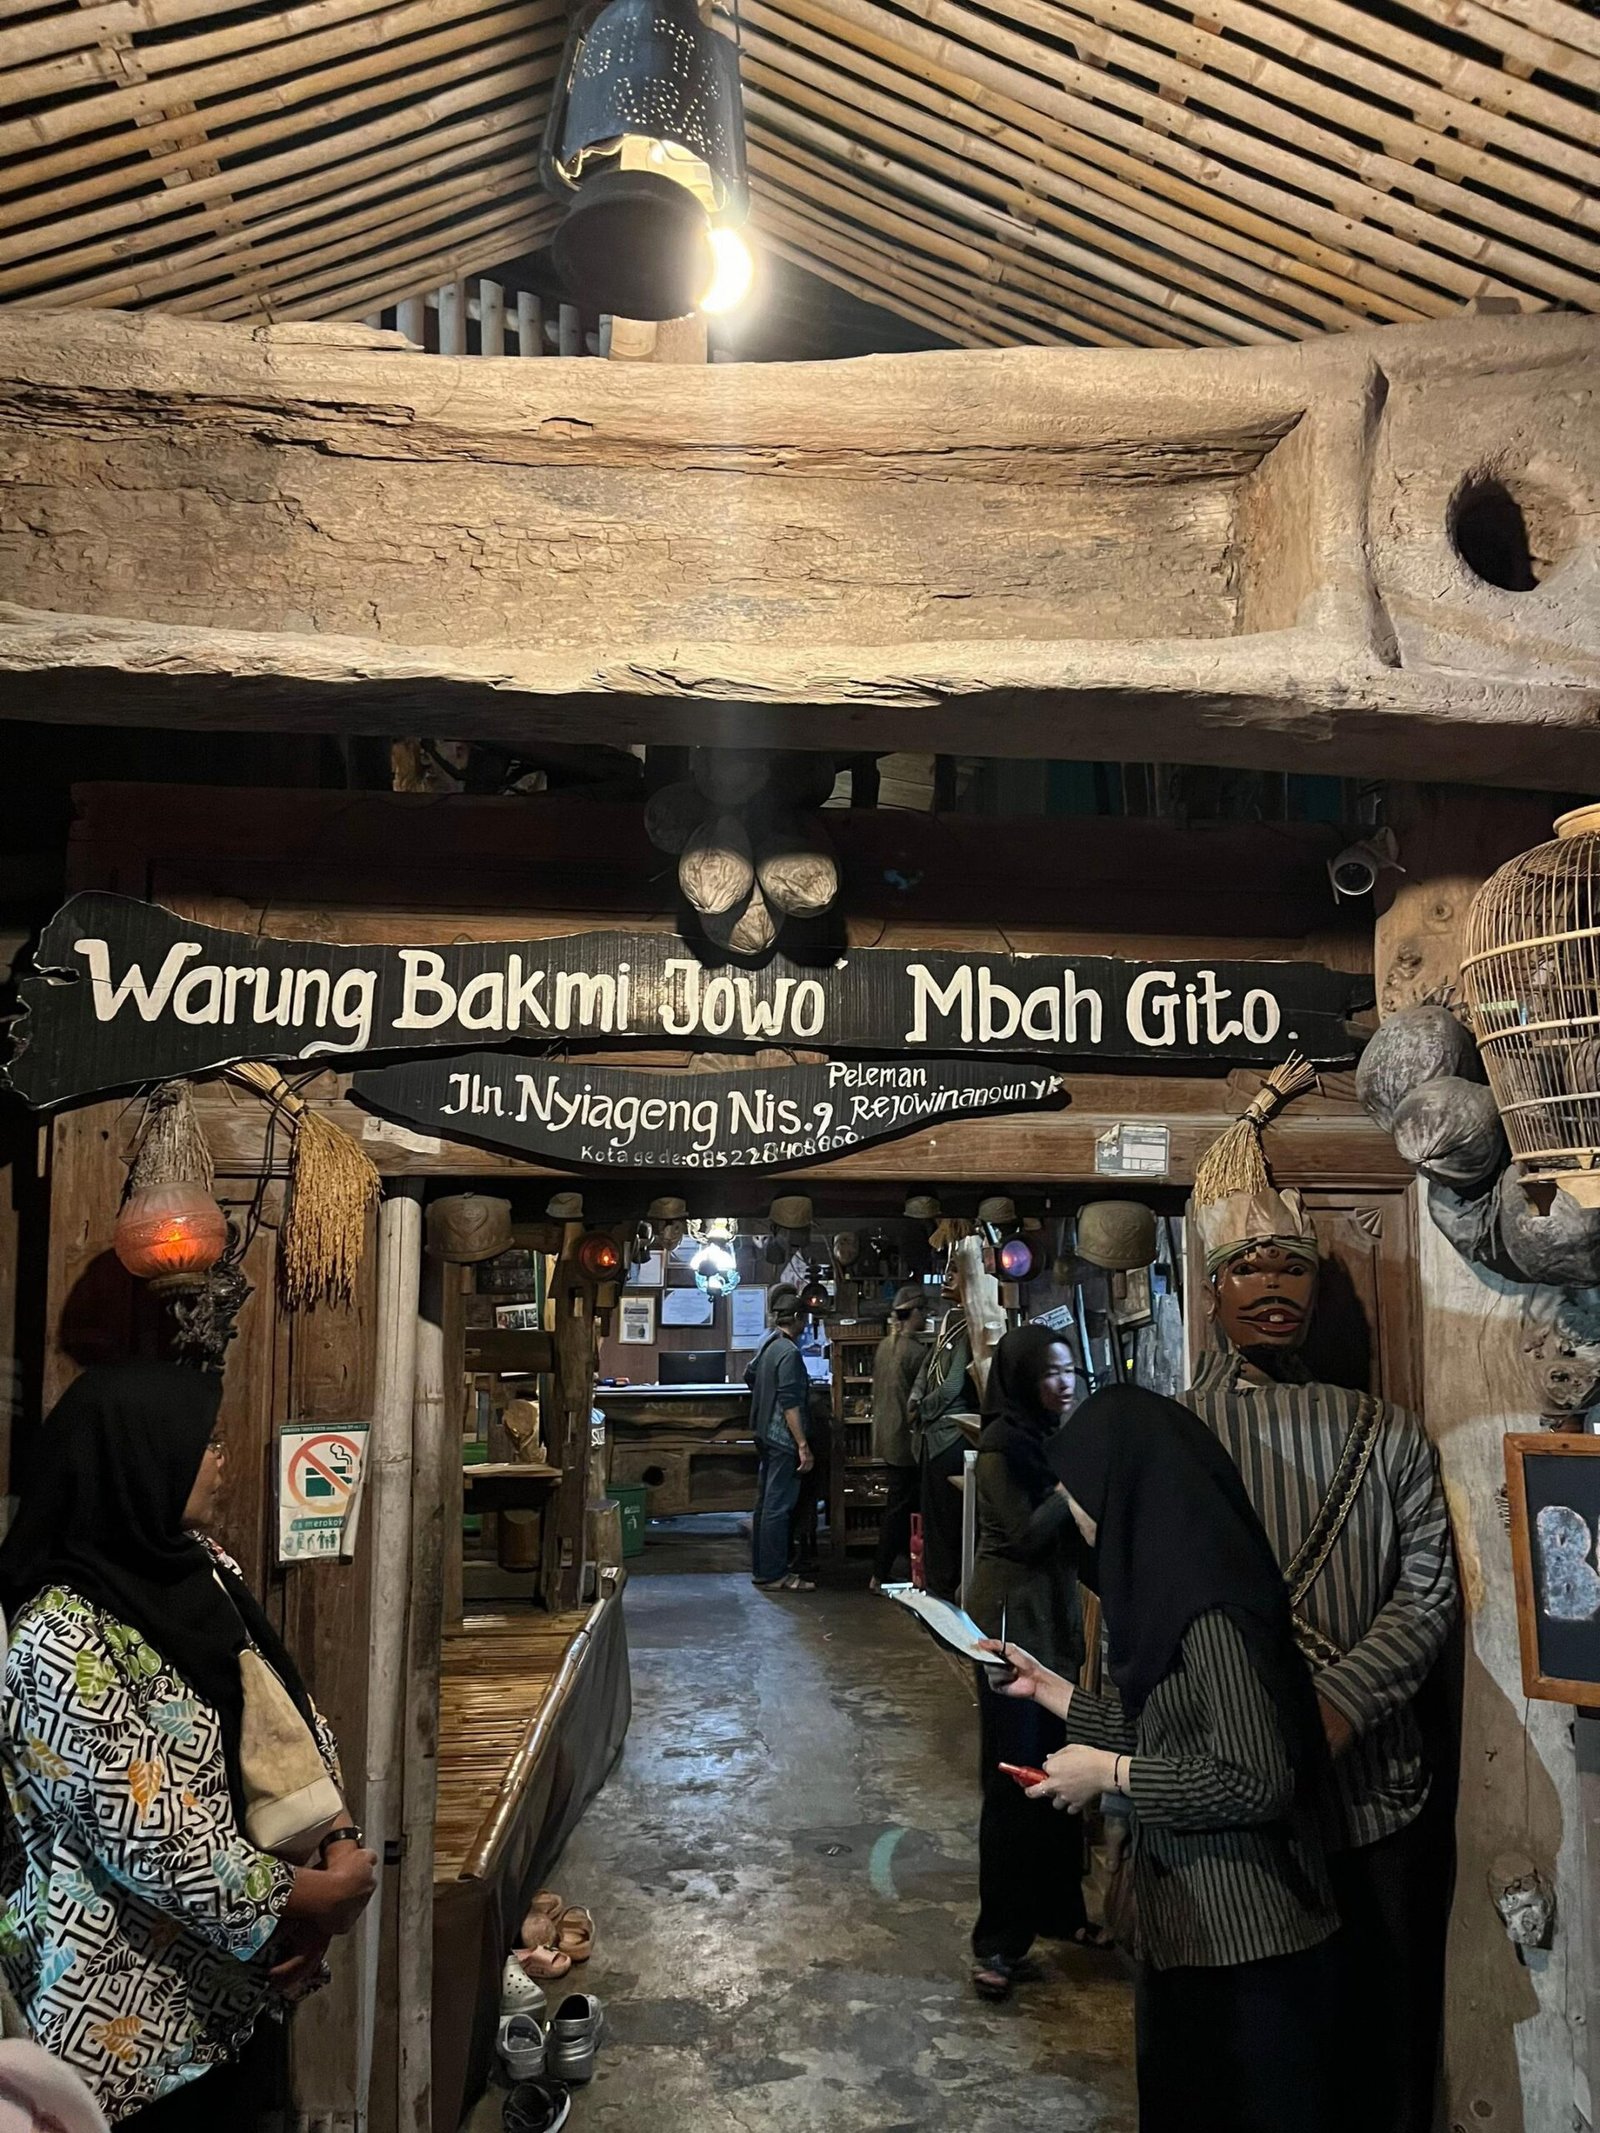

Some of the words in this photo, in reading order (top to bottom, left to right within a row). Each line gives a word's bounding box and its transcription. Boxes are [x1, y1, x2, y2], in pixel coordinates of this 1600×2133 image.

[75, 938, 377, 1059] Warung
[392, 949, 634, 1033] Bakmi
[657, 957, 826, 1037] Jowo
[905, 963, 1103, 1044] Mbah
[1126, 969, 1299, 1046] Gito.
[439, 1073, 514, 1117] Jln.
[514, 1074, 719, 1152] Nyiageng
